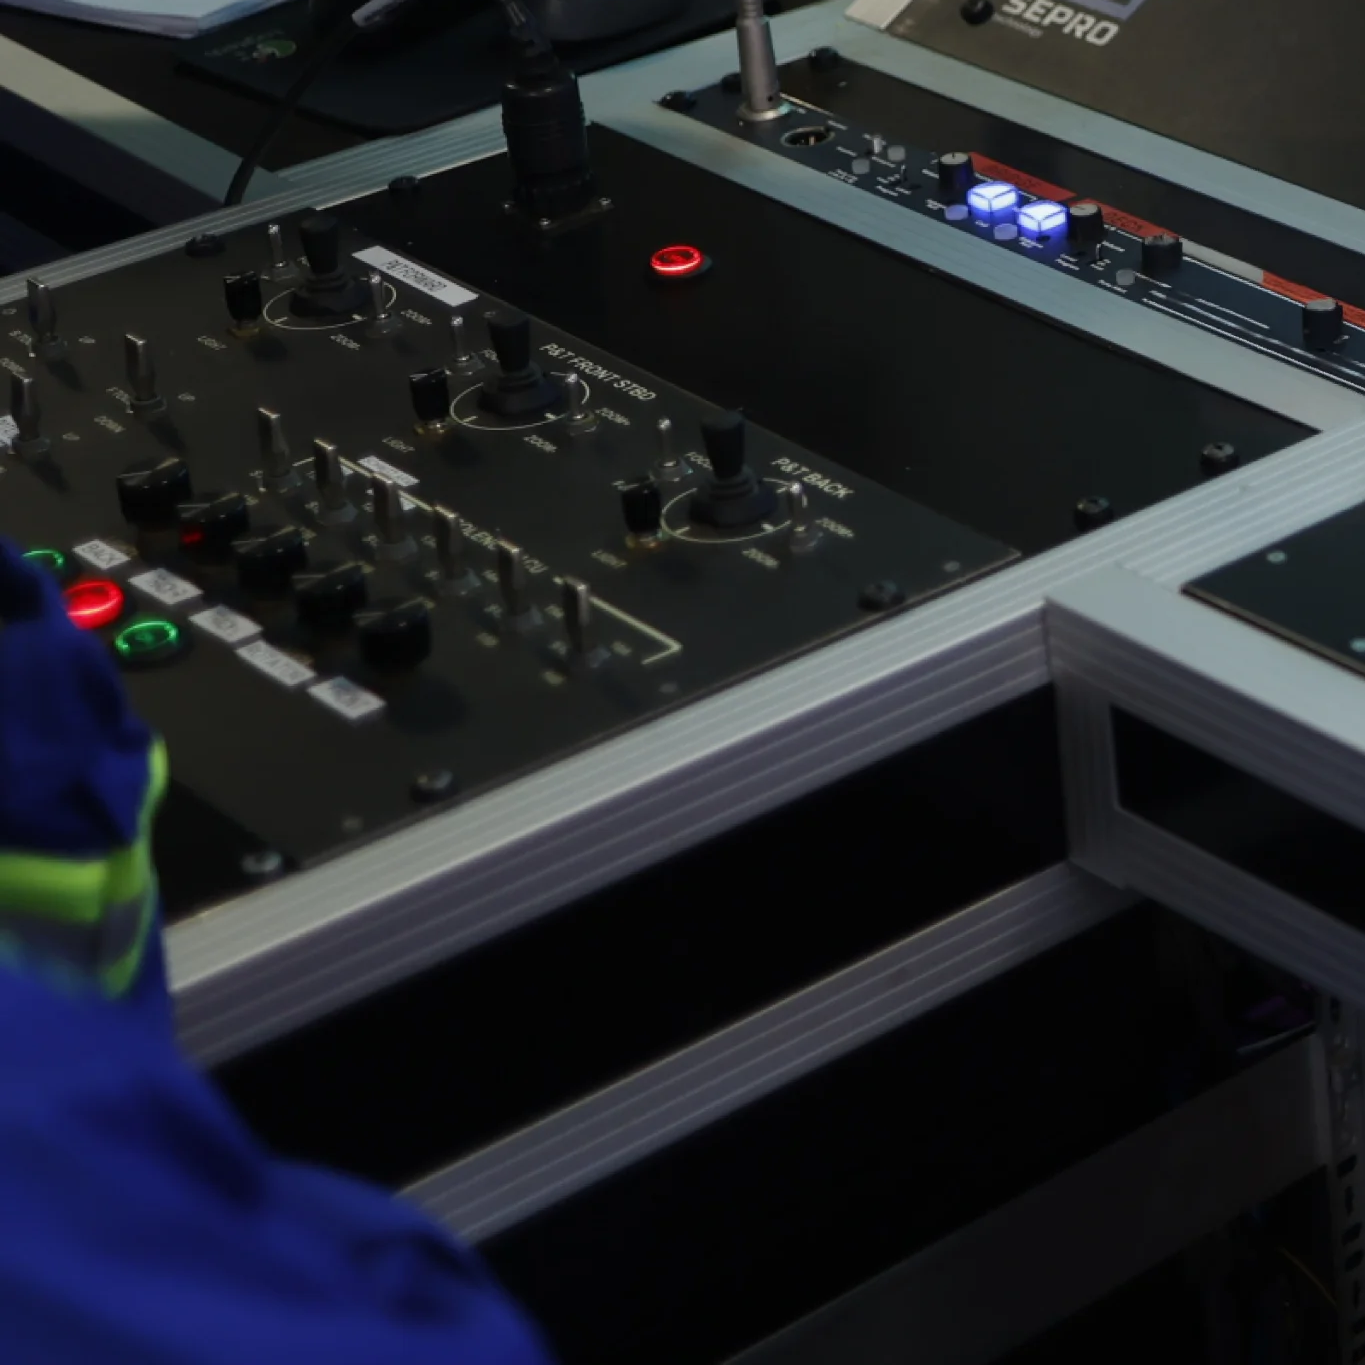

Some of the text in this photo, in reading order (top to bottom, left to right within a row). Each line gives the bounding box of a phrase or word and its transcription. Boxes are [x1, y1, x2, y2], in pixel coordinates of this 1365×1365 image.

[540, 343, 657, 402] P&T FRONT STBD
[771, 456, 855, 500] P&T BACK
